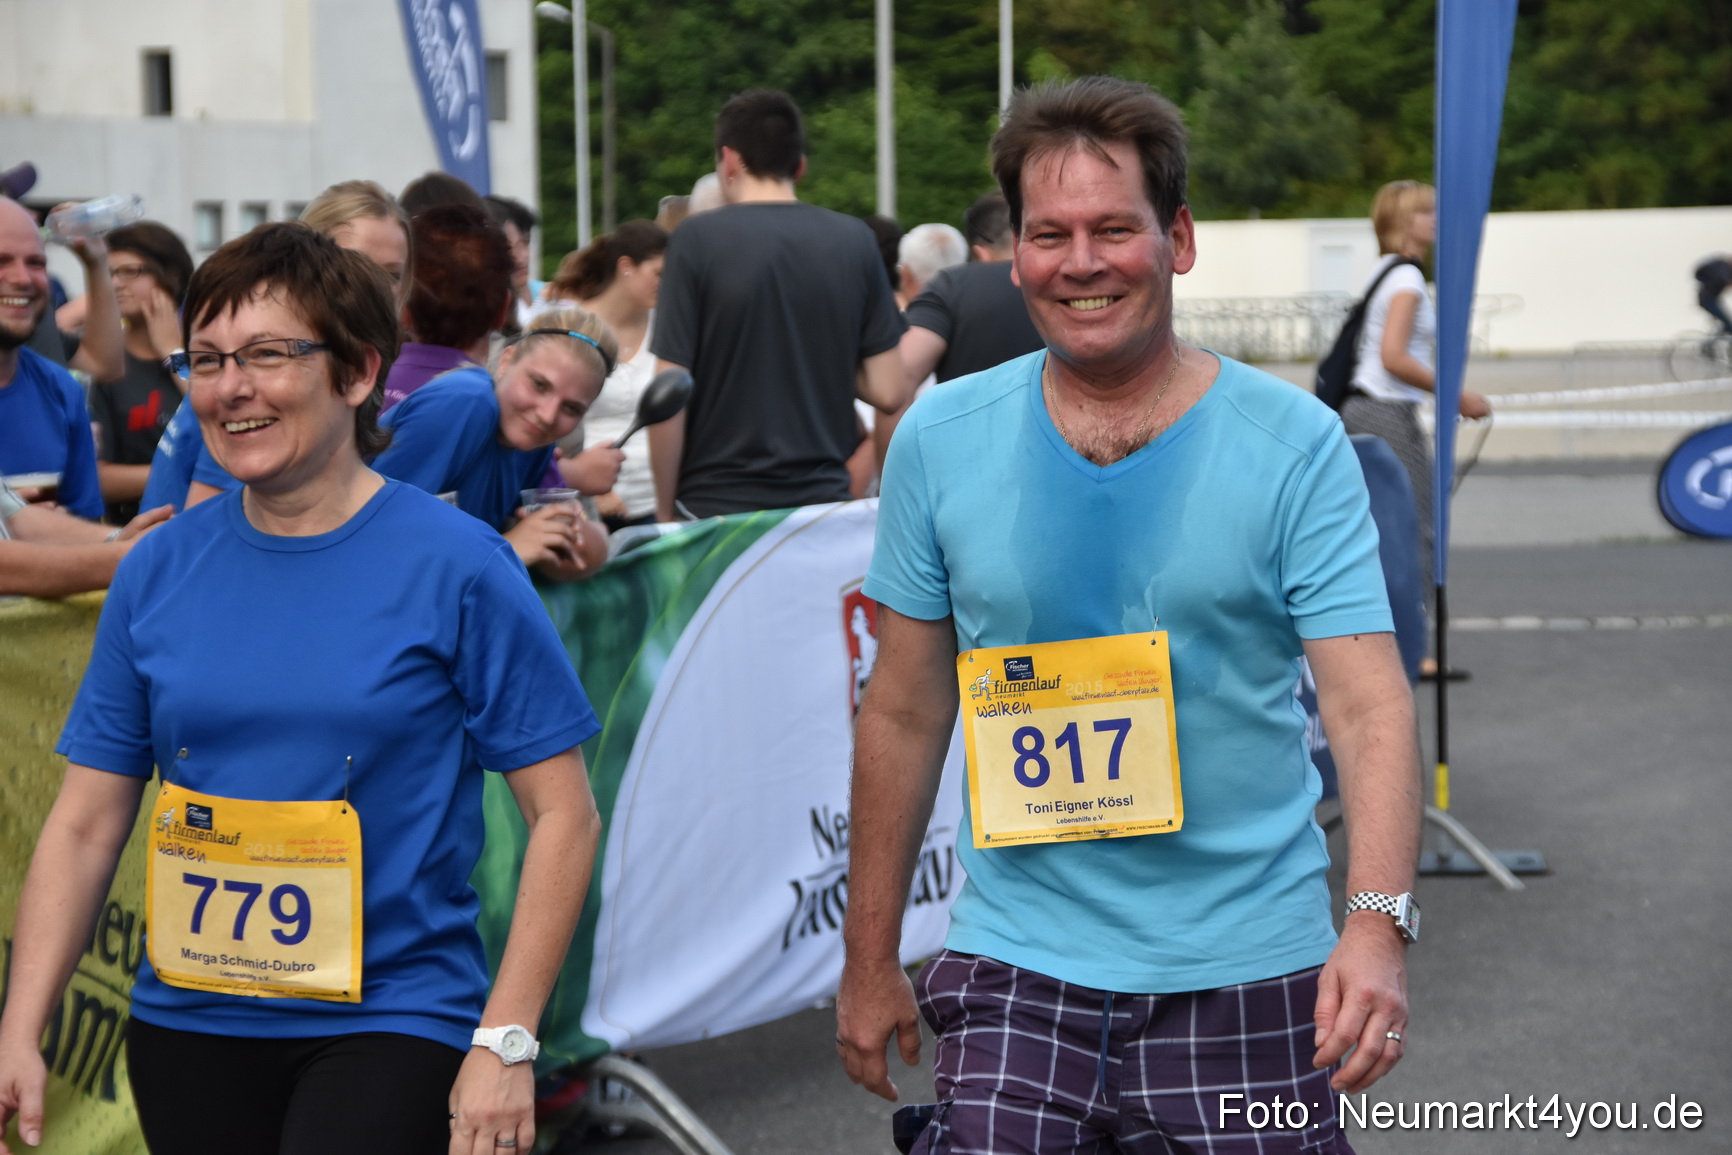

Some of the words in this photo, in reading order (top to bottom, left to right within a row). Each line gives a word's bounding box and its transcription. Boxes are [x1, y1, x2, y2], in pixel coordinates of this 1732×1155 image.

[994, 674, 1062, 694] firmenlauf
[976, 701, 1032, 718] walken
[1012, 717, 1132, 788] 817
[1025, 801, 1053, 815] Toni
[1055, 799, 1094, 814] Eigner
[1098, 795, 1134, 809] Kössl
[1056, 816, 1092, 825] Lebenshilfe
[1092, 814, 1106, 822] e.V.
[173, 821, 242, 846] firmenlauf
[157, 840, 207, 864] walken
[182, 872, 312, 946] 779
[181, 947, 217, 966] Marga
[219, 954, 316, 972] Schmid-Dubro
